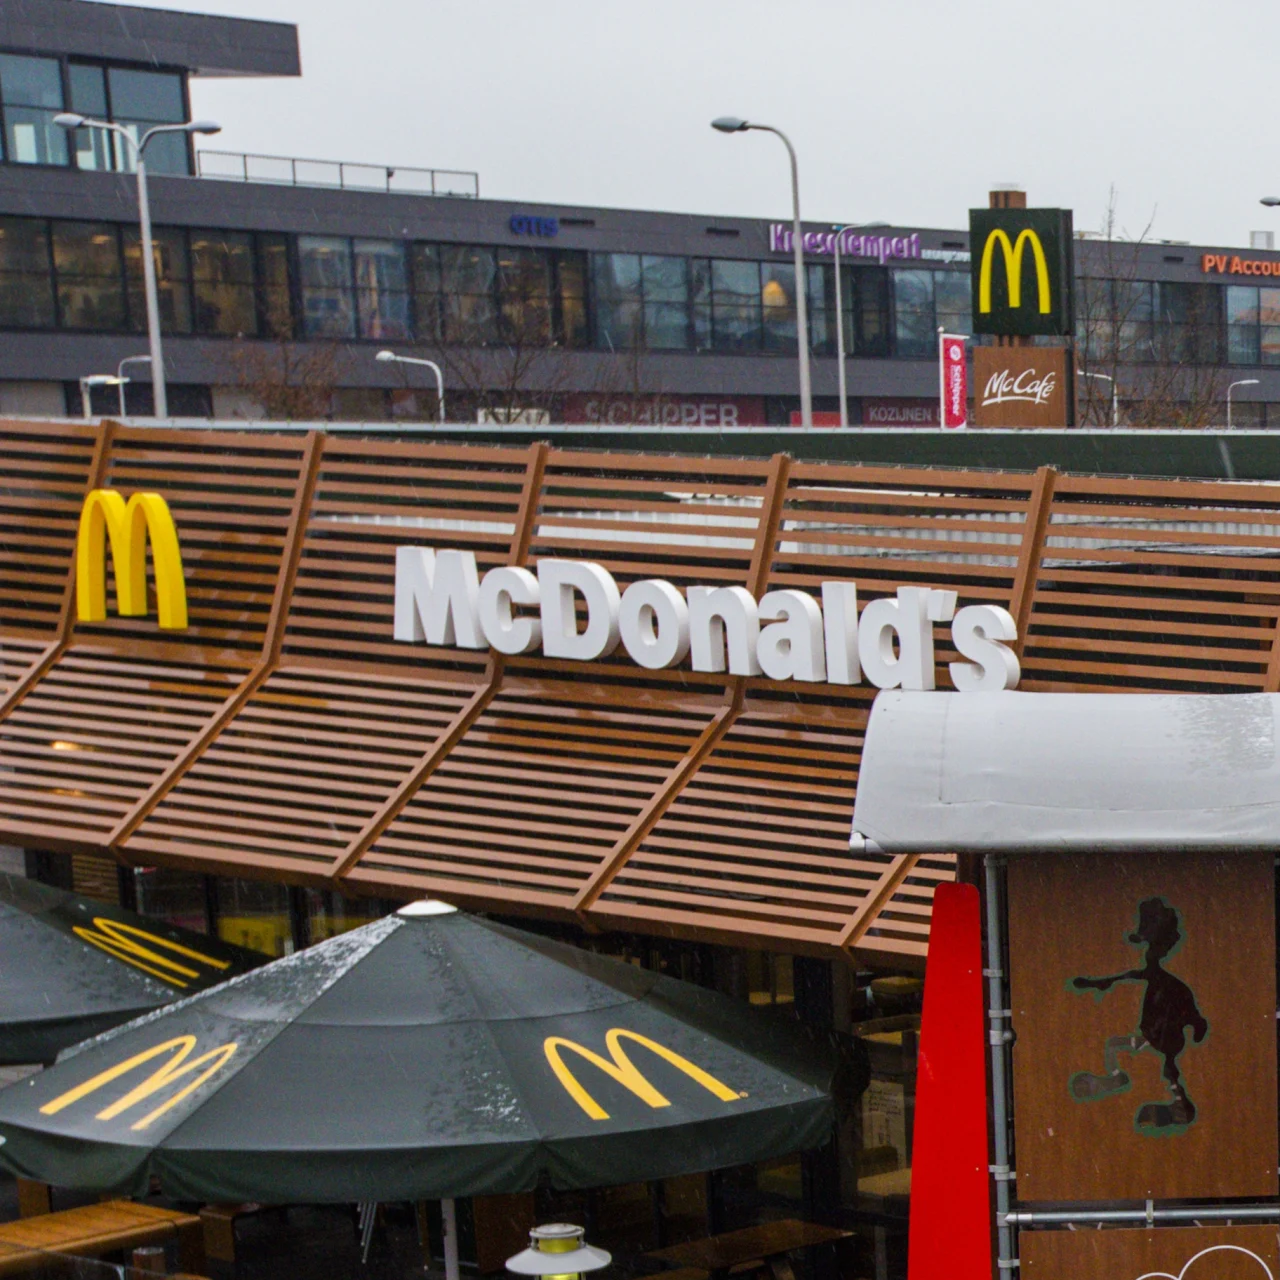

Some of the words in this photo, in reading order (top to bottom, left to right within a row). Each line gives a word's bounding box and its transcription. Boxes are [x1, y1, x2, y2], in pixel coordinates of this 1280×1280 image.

[1202, 253, 1227, 273] PV
[982, 368, 1056, 405] McCafé
[869, 407, 932, 421] KOZIJNEN
[393, 545, 1022, 691] McDonald's
